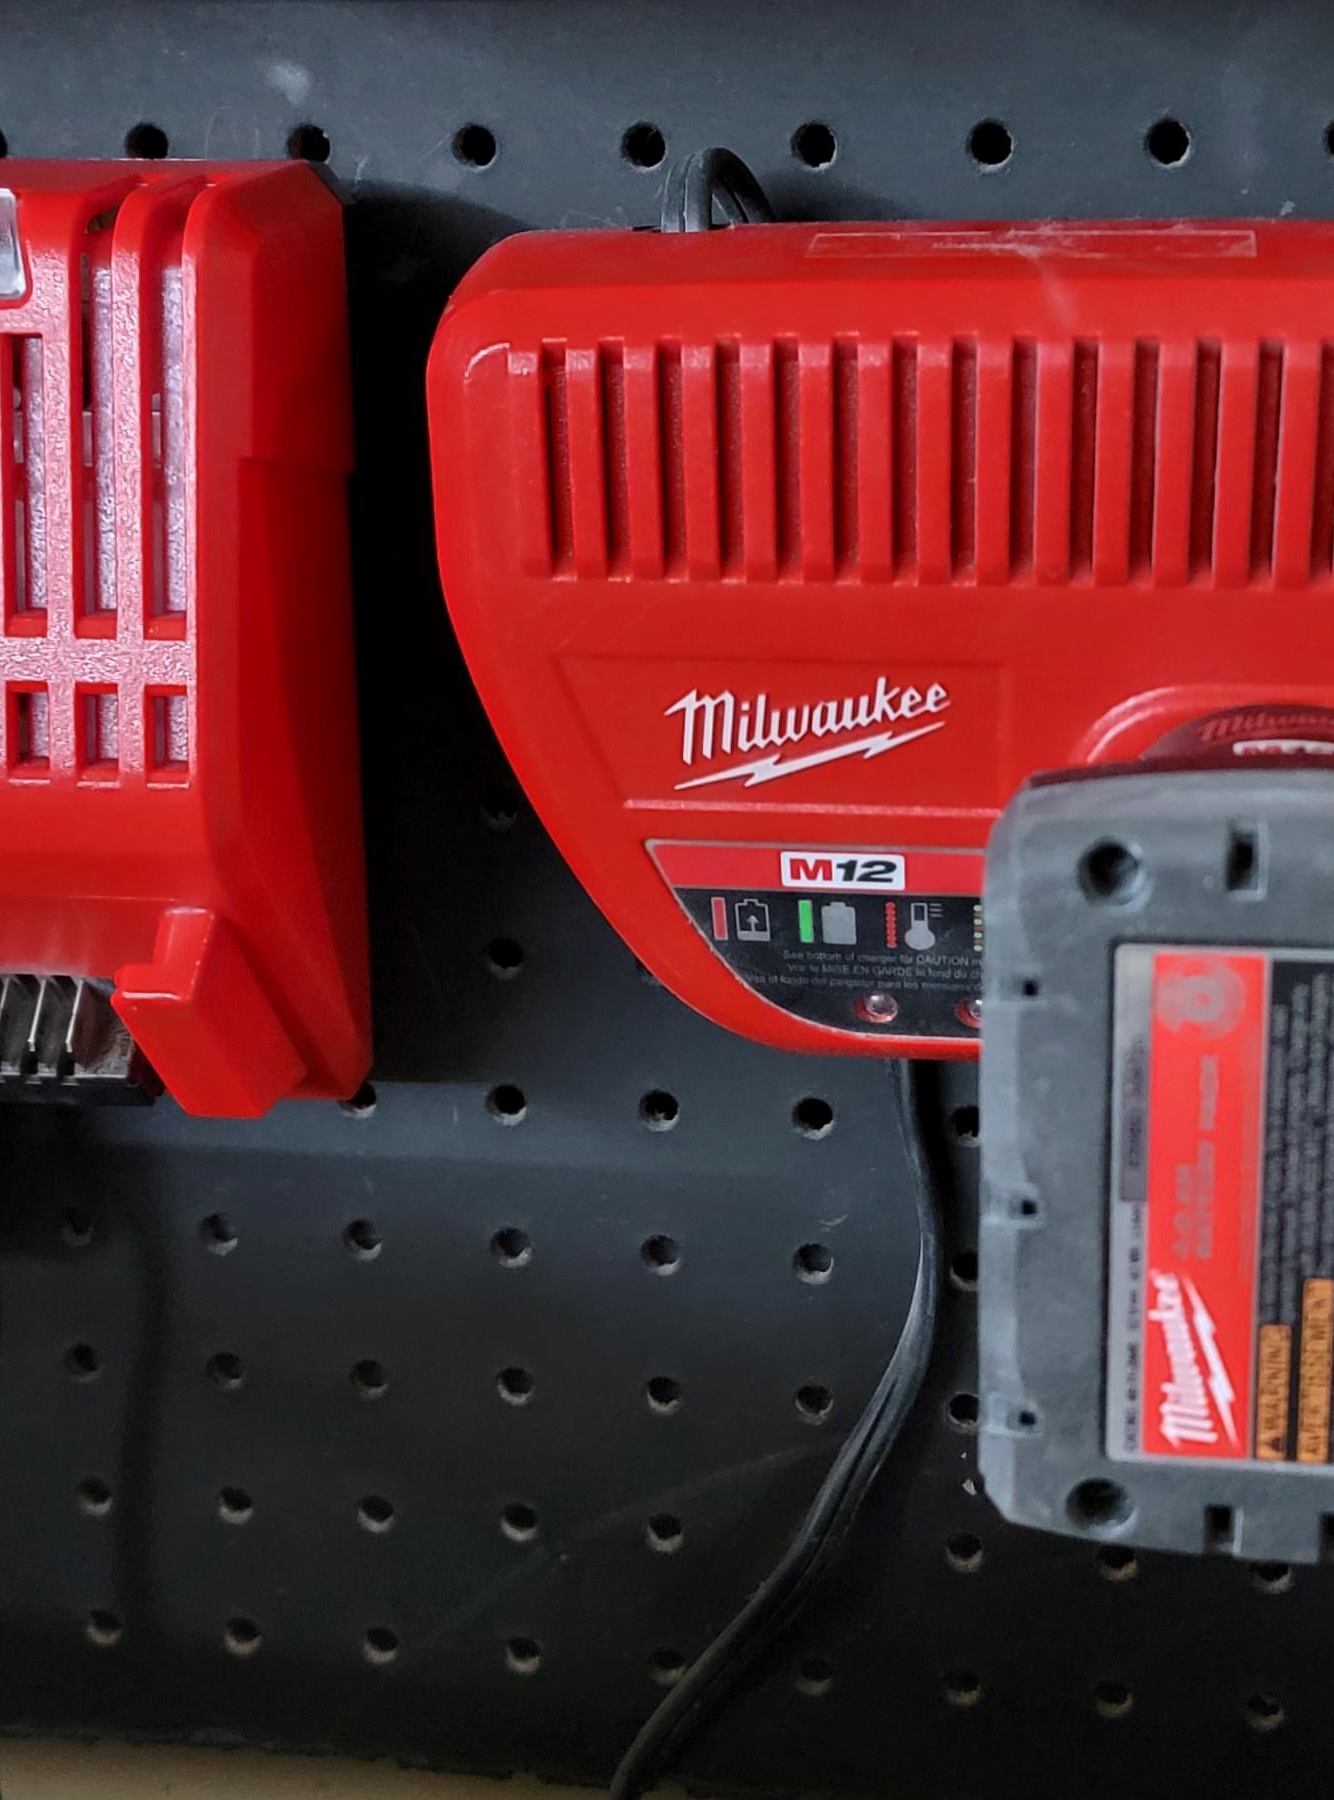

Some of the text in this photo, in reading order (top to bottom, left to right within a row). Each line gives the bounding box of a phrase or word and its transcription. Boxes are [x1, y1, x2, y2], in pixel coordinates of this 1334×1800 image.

[664, 676, 951, 766] Milwaukee
[788, 858, 898, 884] M12
[1147, 1270, 1220, 1449] Milwaukee
